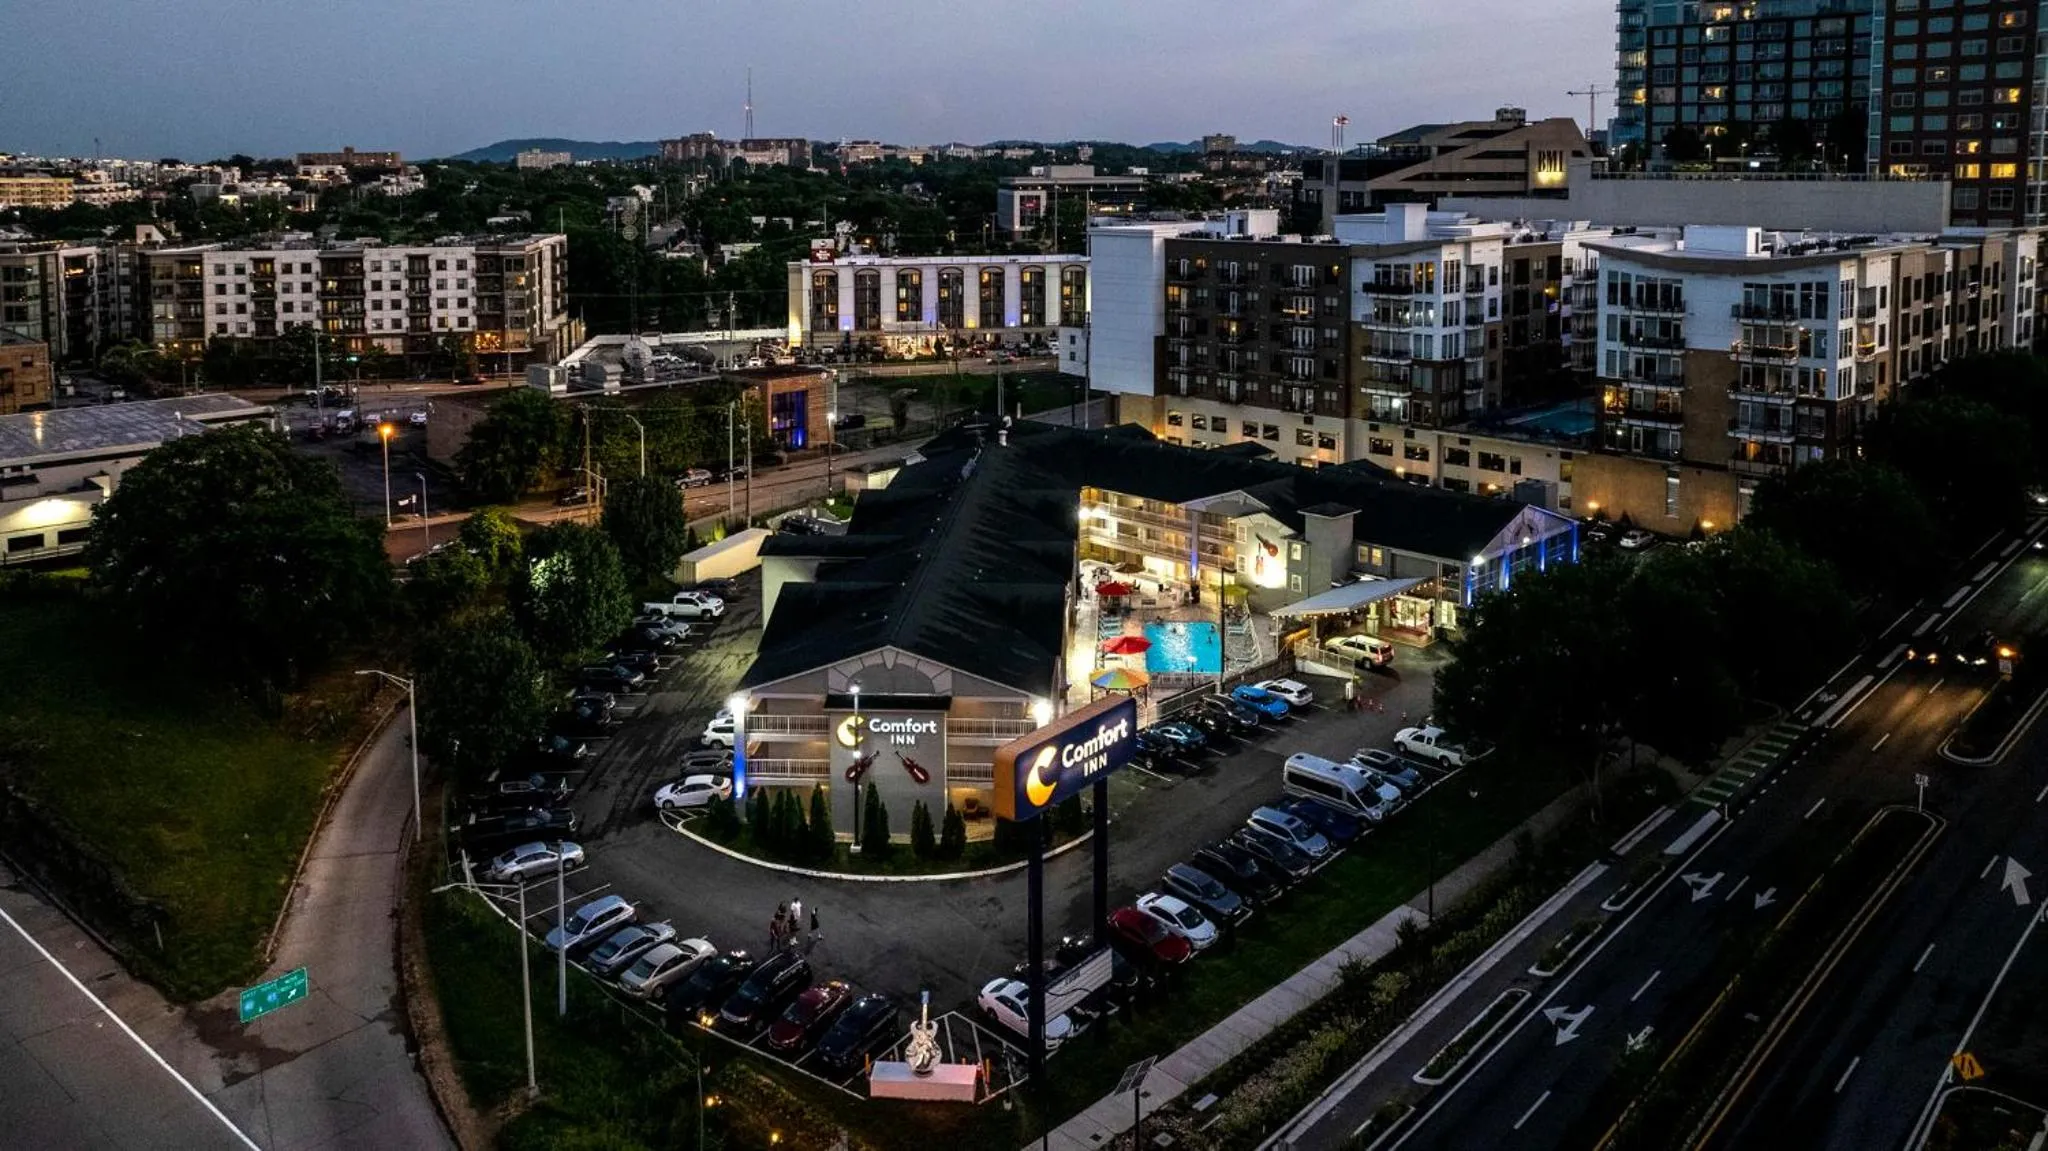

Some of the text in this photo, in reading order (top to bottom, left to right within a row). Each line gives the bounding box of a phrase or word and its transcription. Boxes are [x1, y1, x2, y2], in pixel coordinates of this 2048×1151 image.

[1538, 150, 1563, 172] BMI
[869, 718, 937, 733] Comfort
[890, 734, 915, 744] INN
[1062, 718, 1128, 768] Comfort
[1083, 752, 1107, 776] INN
